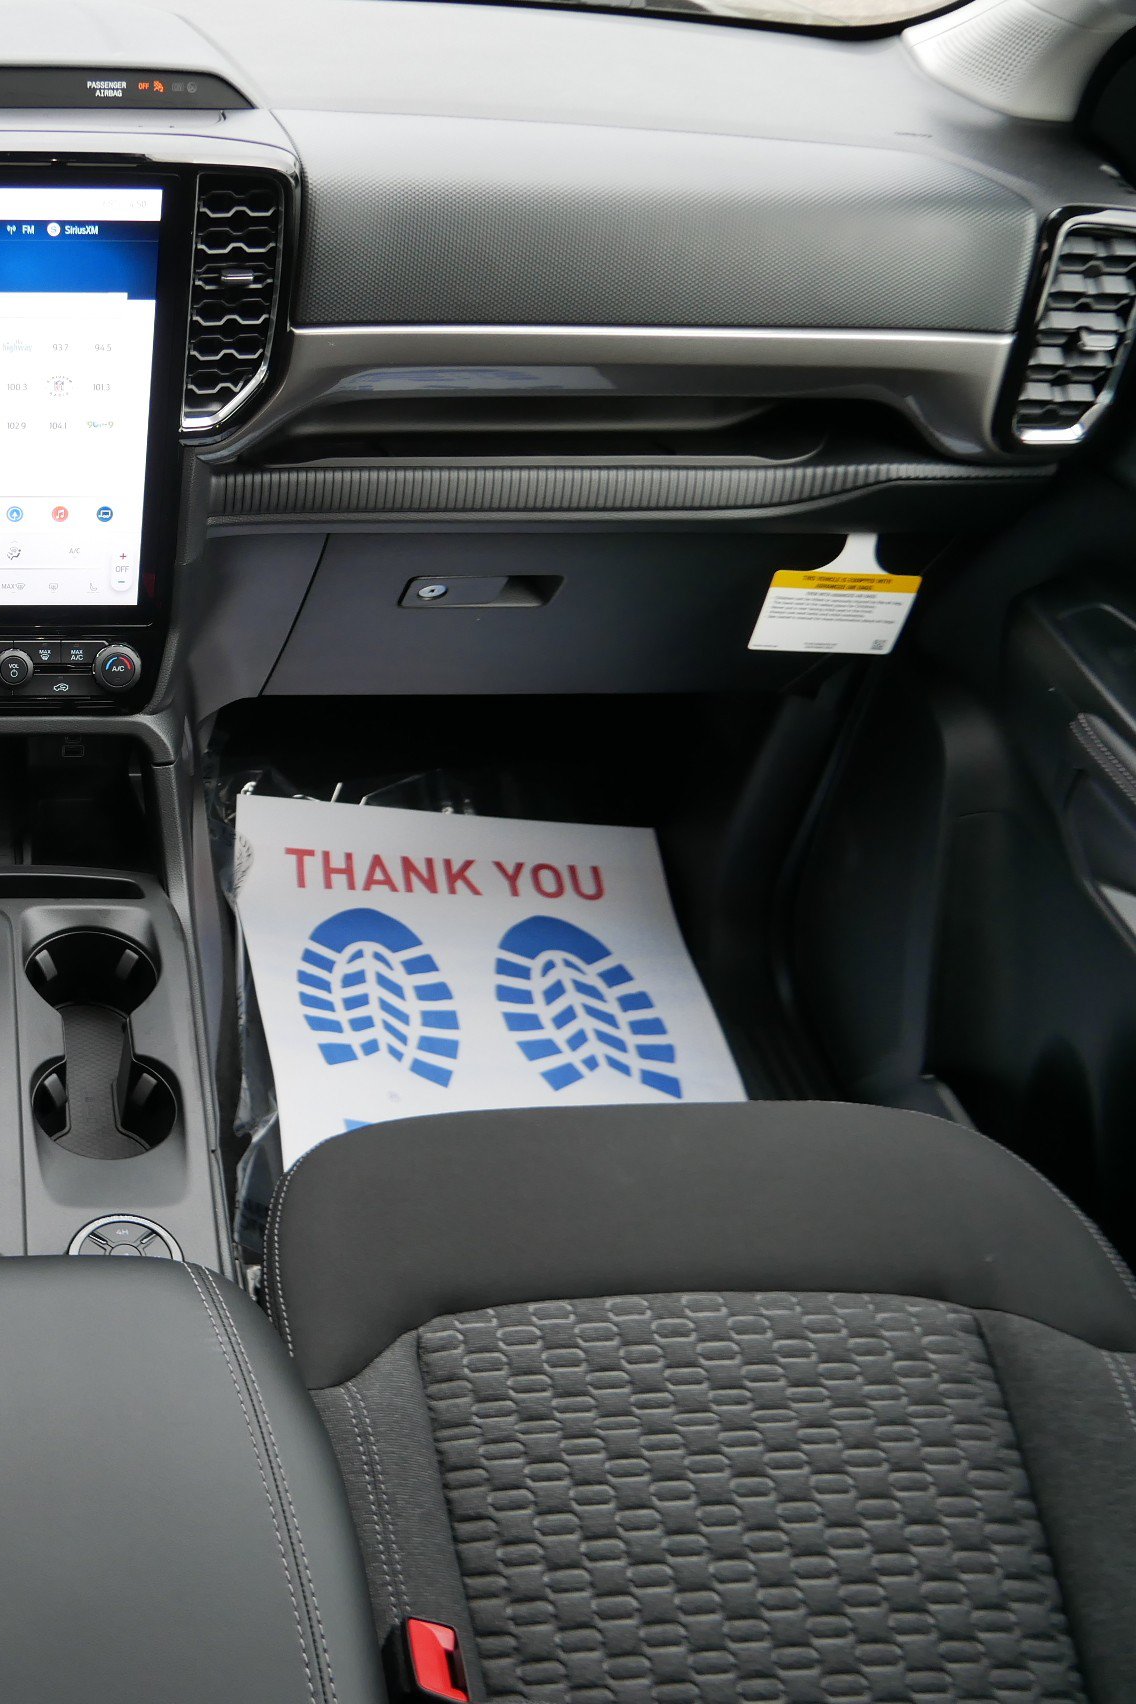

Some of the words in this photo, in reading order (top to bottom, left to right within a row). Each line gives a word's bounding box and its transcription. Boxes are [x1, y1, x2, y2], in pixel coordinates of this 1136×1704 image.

[87, 81, 127, 89] PASSENGER
[138, 82, 150, 90] OFF
[95, 89, 123, 97] AIRBAG
[22, 224, 35, 235] FM
[64, 224, 99, 235] SiriusXM
[115, 565, 130, 573] OFF
[284, 847, 483, 896] THANK
[492, 860, 605, 901] YOU
[115, 1228, 130, 1236] 4H
